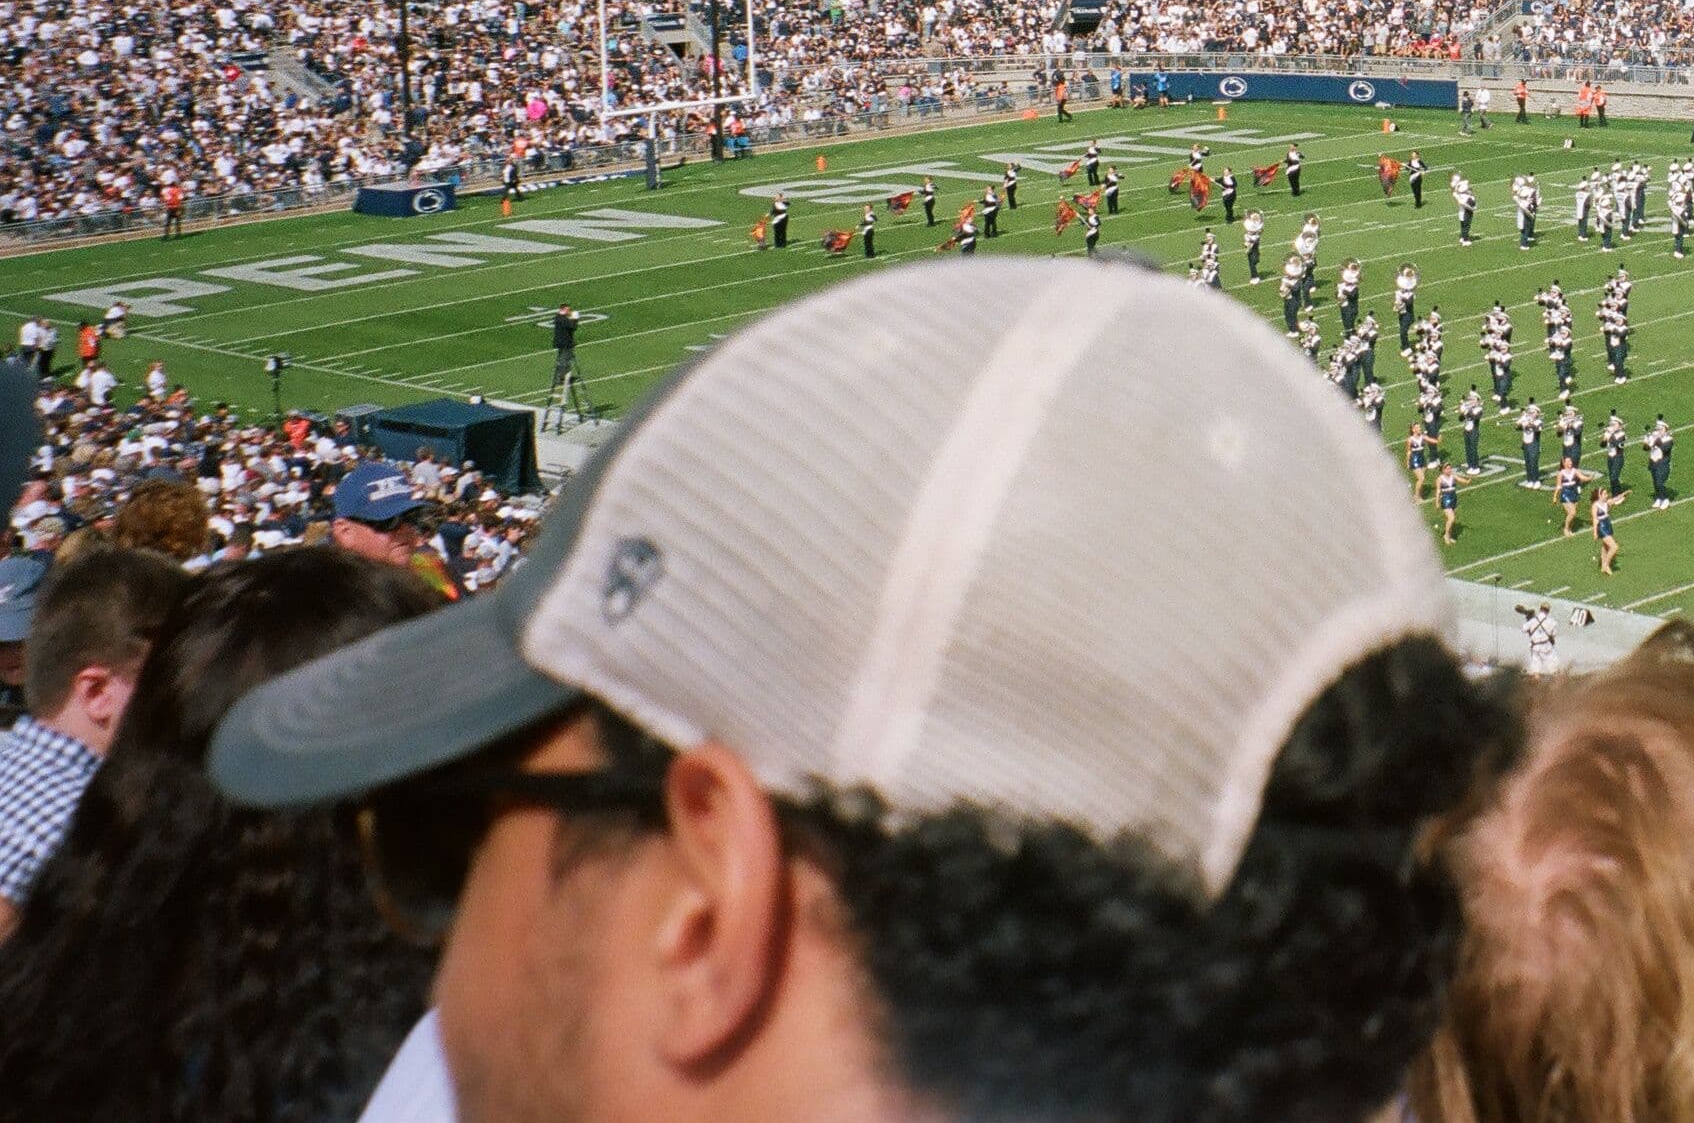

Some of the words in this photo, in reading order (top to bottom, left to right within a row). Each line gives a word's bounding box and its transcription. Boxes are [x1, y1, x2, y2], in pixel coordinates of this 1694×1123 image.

[738, 124, 1326, 204] STATE
[40, 208, 726, 318] PENN
[1571, 608, 1589, 628] 40
